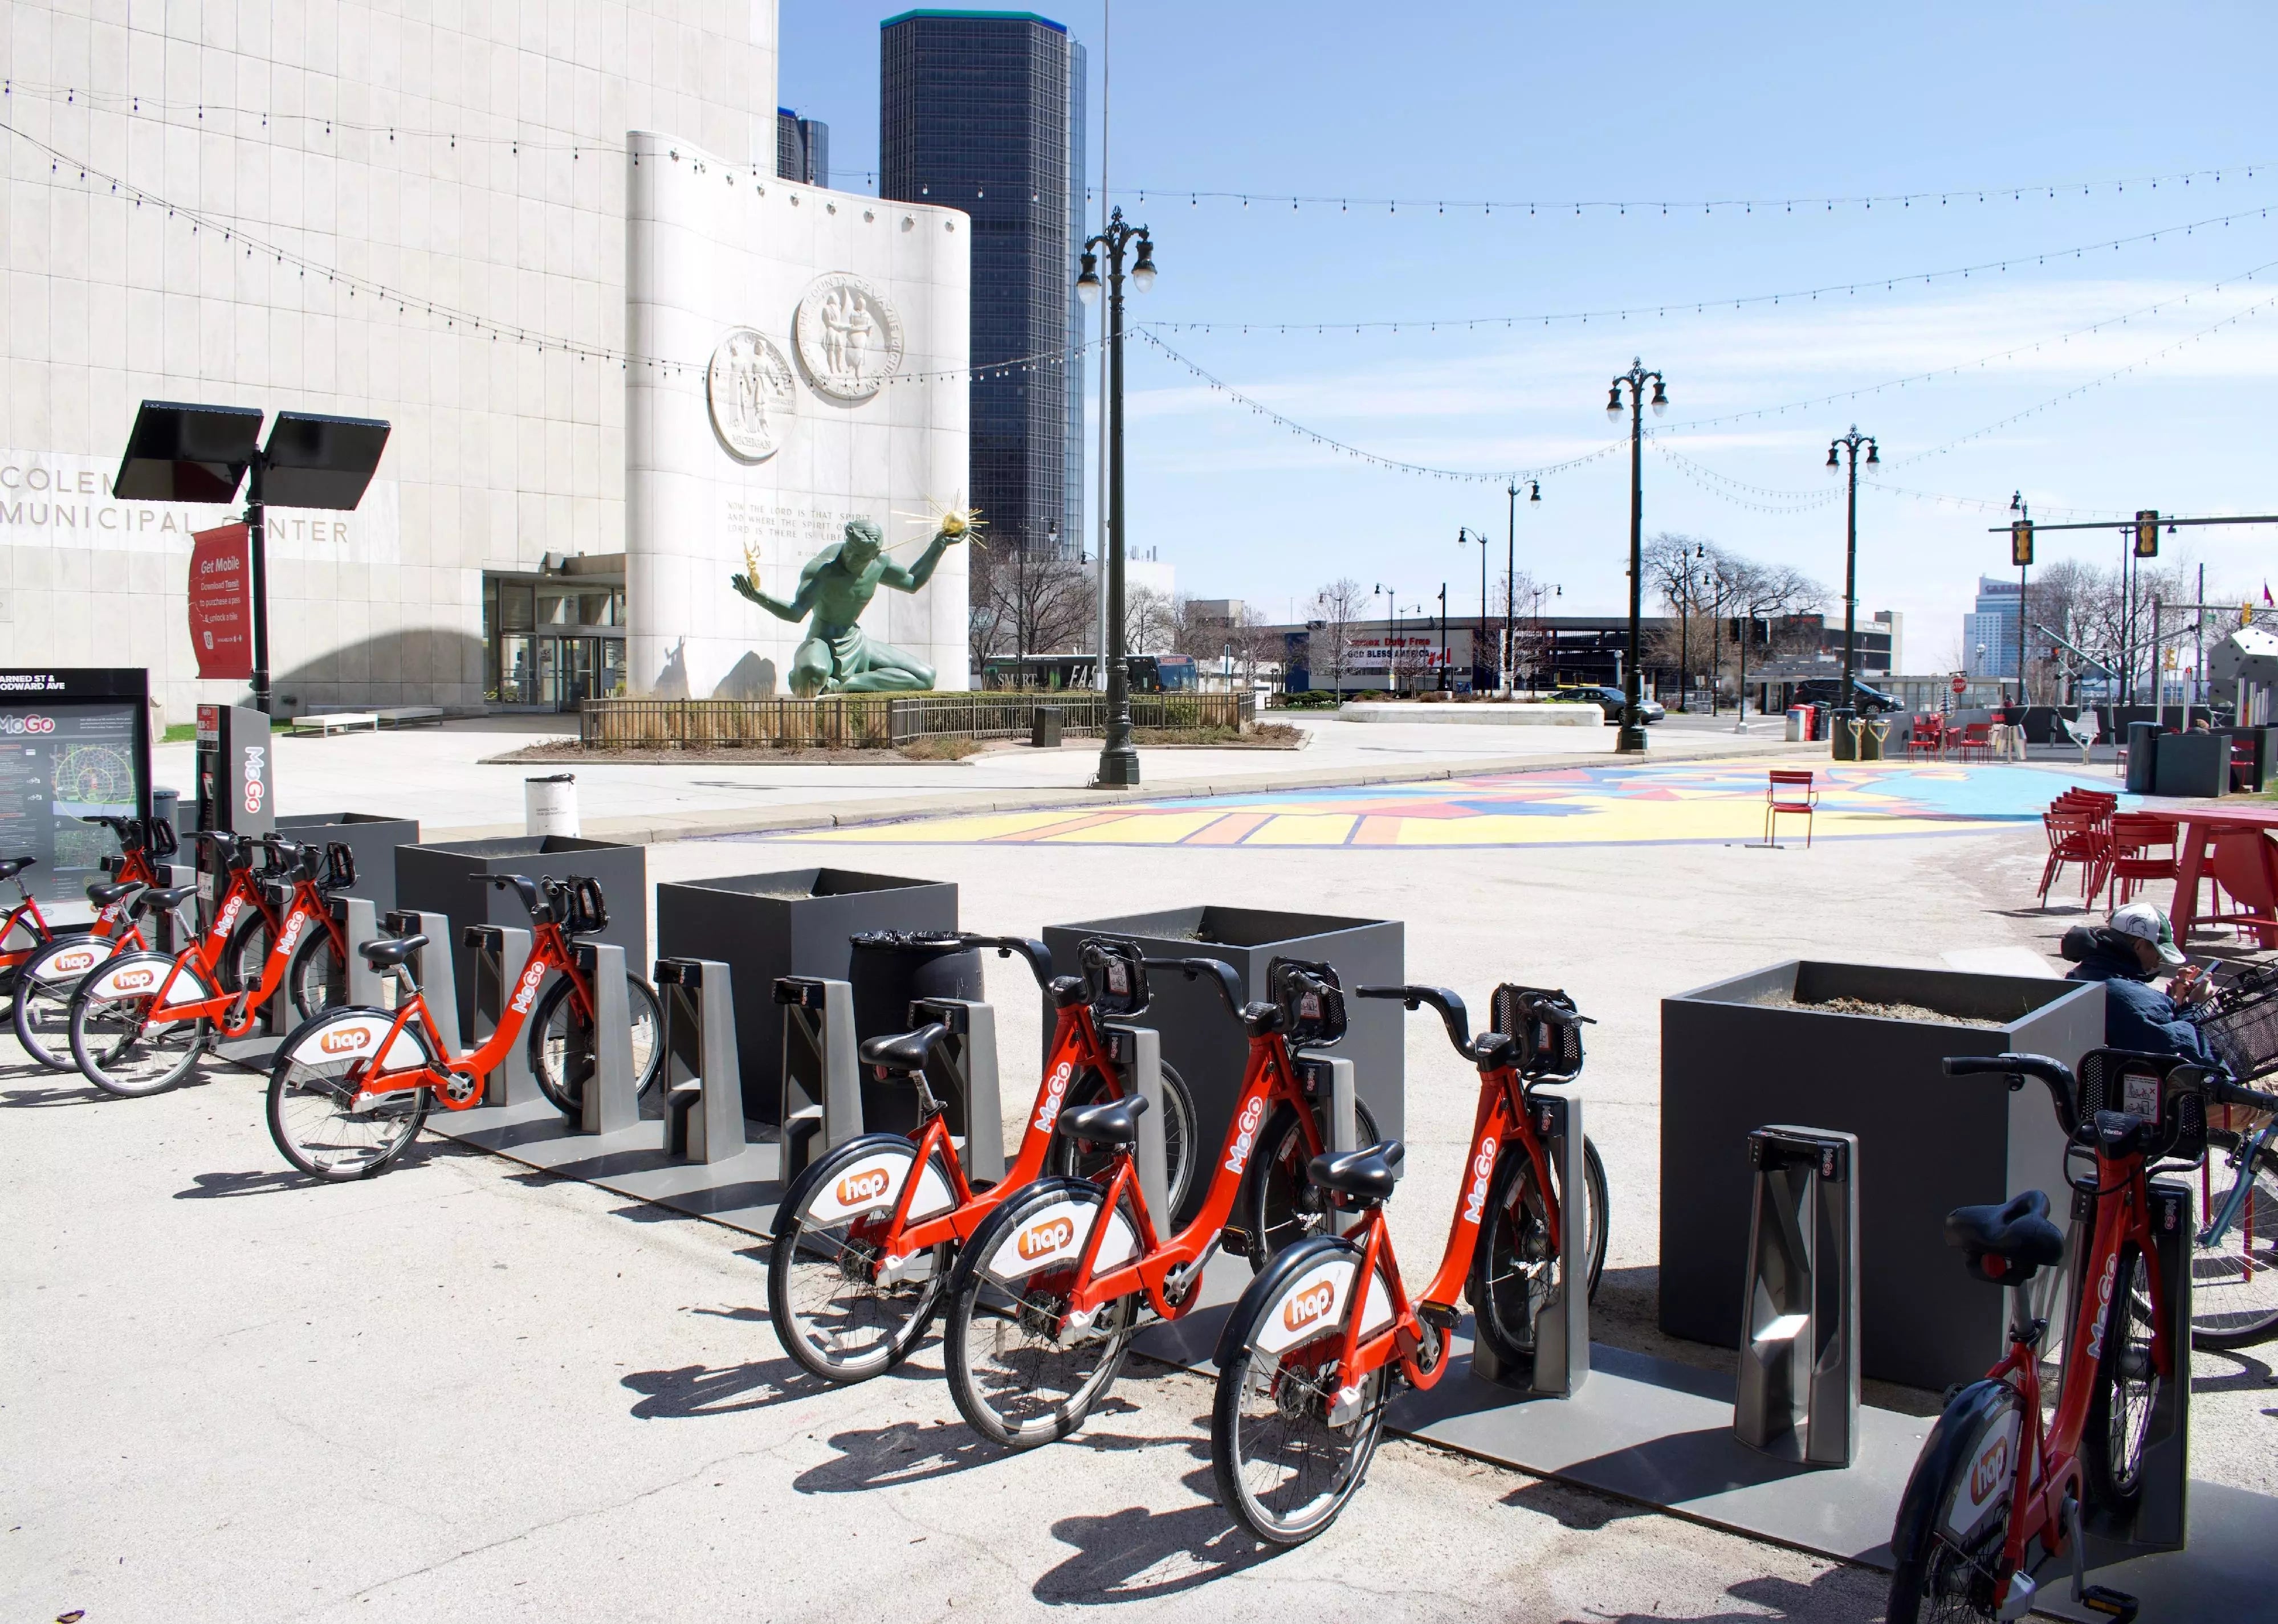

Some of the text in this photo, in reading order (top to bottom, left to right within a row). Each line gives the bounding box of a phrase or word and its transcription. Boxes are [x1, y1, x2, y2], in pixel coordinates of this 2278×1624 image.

[855, 279, 869, 291] OF
[732, 434, 771, 450] MICHIGAN
[0, 501, 348, 543] MUNICIPAL NTER
[727, 513, 744, 521] AND
[748, 515, 776, 525] WHERE
[781, 519, 797, 528] THE
[802, 520, 830, 531] SPIRIT
[749, 504, 764, 513] THE
[771, 506, 792, 516] LORD
[798, 508, 806, 517] IS
[811, 511, 833, 520] THAT
[728, 524, 749, 534] LORD
[769, 528, 798, 538] THERE
[201, 556, 239, 574] Get Mobile
[201, 579, 239, 591] Download Transit
[205, 598, 227, 607] purchase
[231, 597, 241, 606] pass
[210, 613, 226, 622] unlock
[1385, 637, 1407, 647] Duty
[245, 746, 265, 813] MoGo
[214, 896, 242, 937] MoGo
[276, 911, 305, 955] MoGo
[512, 961, 545, 1014] MoGo
[1034, 1062, 1071, 1133] MoGo
[1542, 1105, 1550, 1131] MoGo
[1225, 1096, 1262, 1174] MoGo
[1823, 1148, 1833, 1176] MoGo
[1464, 1137, 1496, 1225] MoGo
[2164, 1199, 2176, 1230] MoGo
[2087, 1253, 2117, 1359] MoGo
